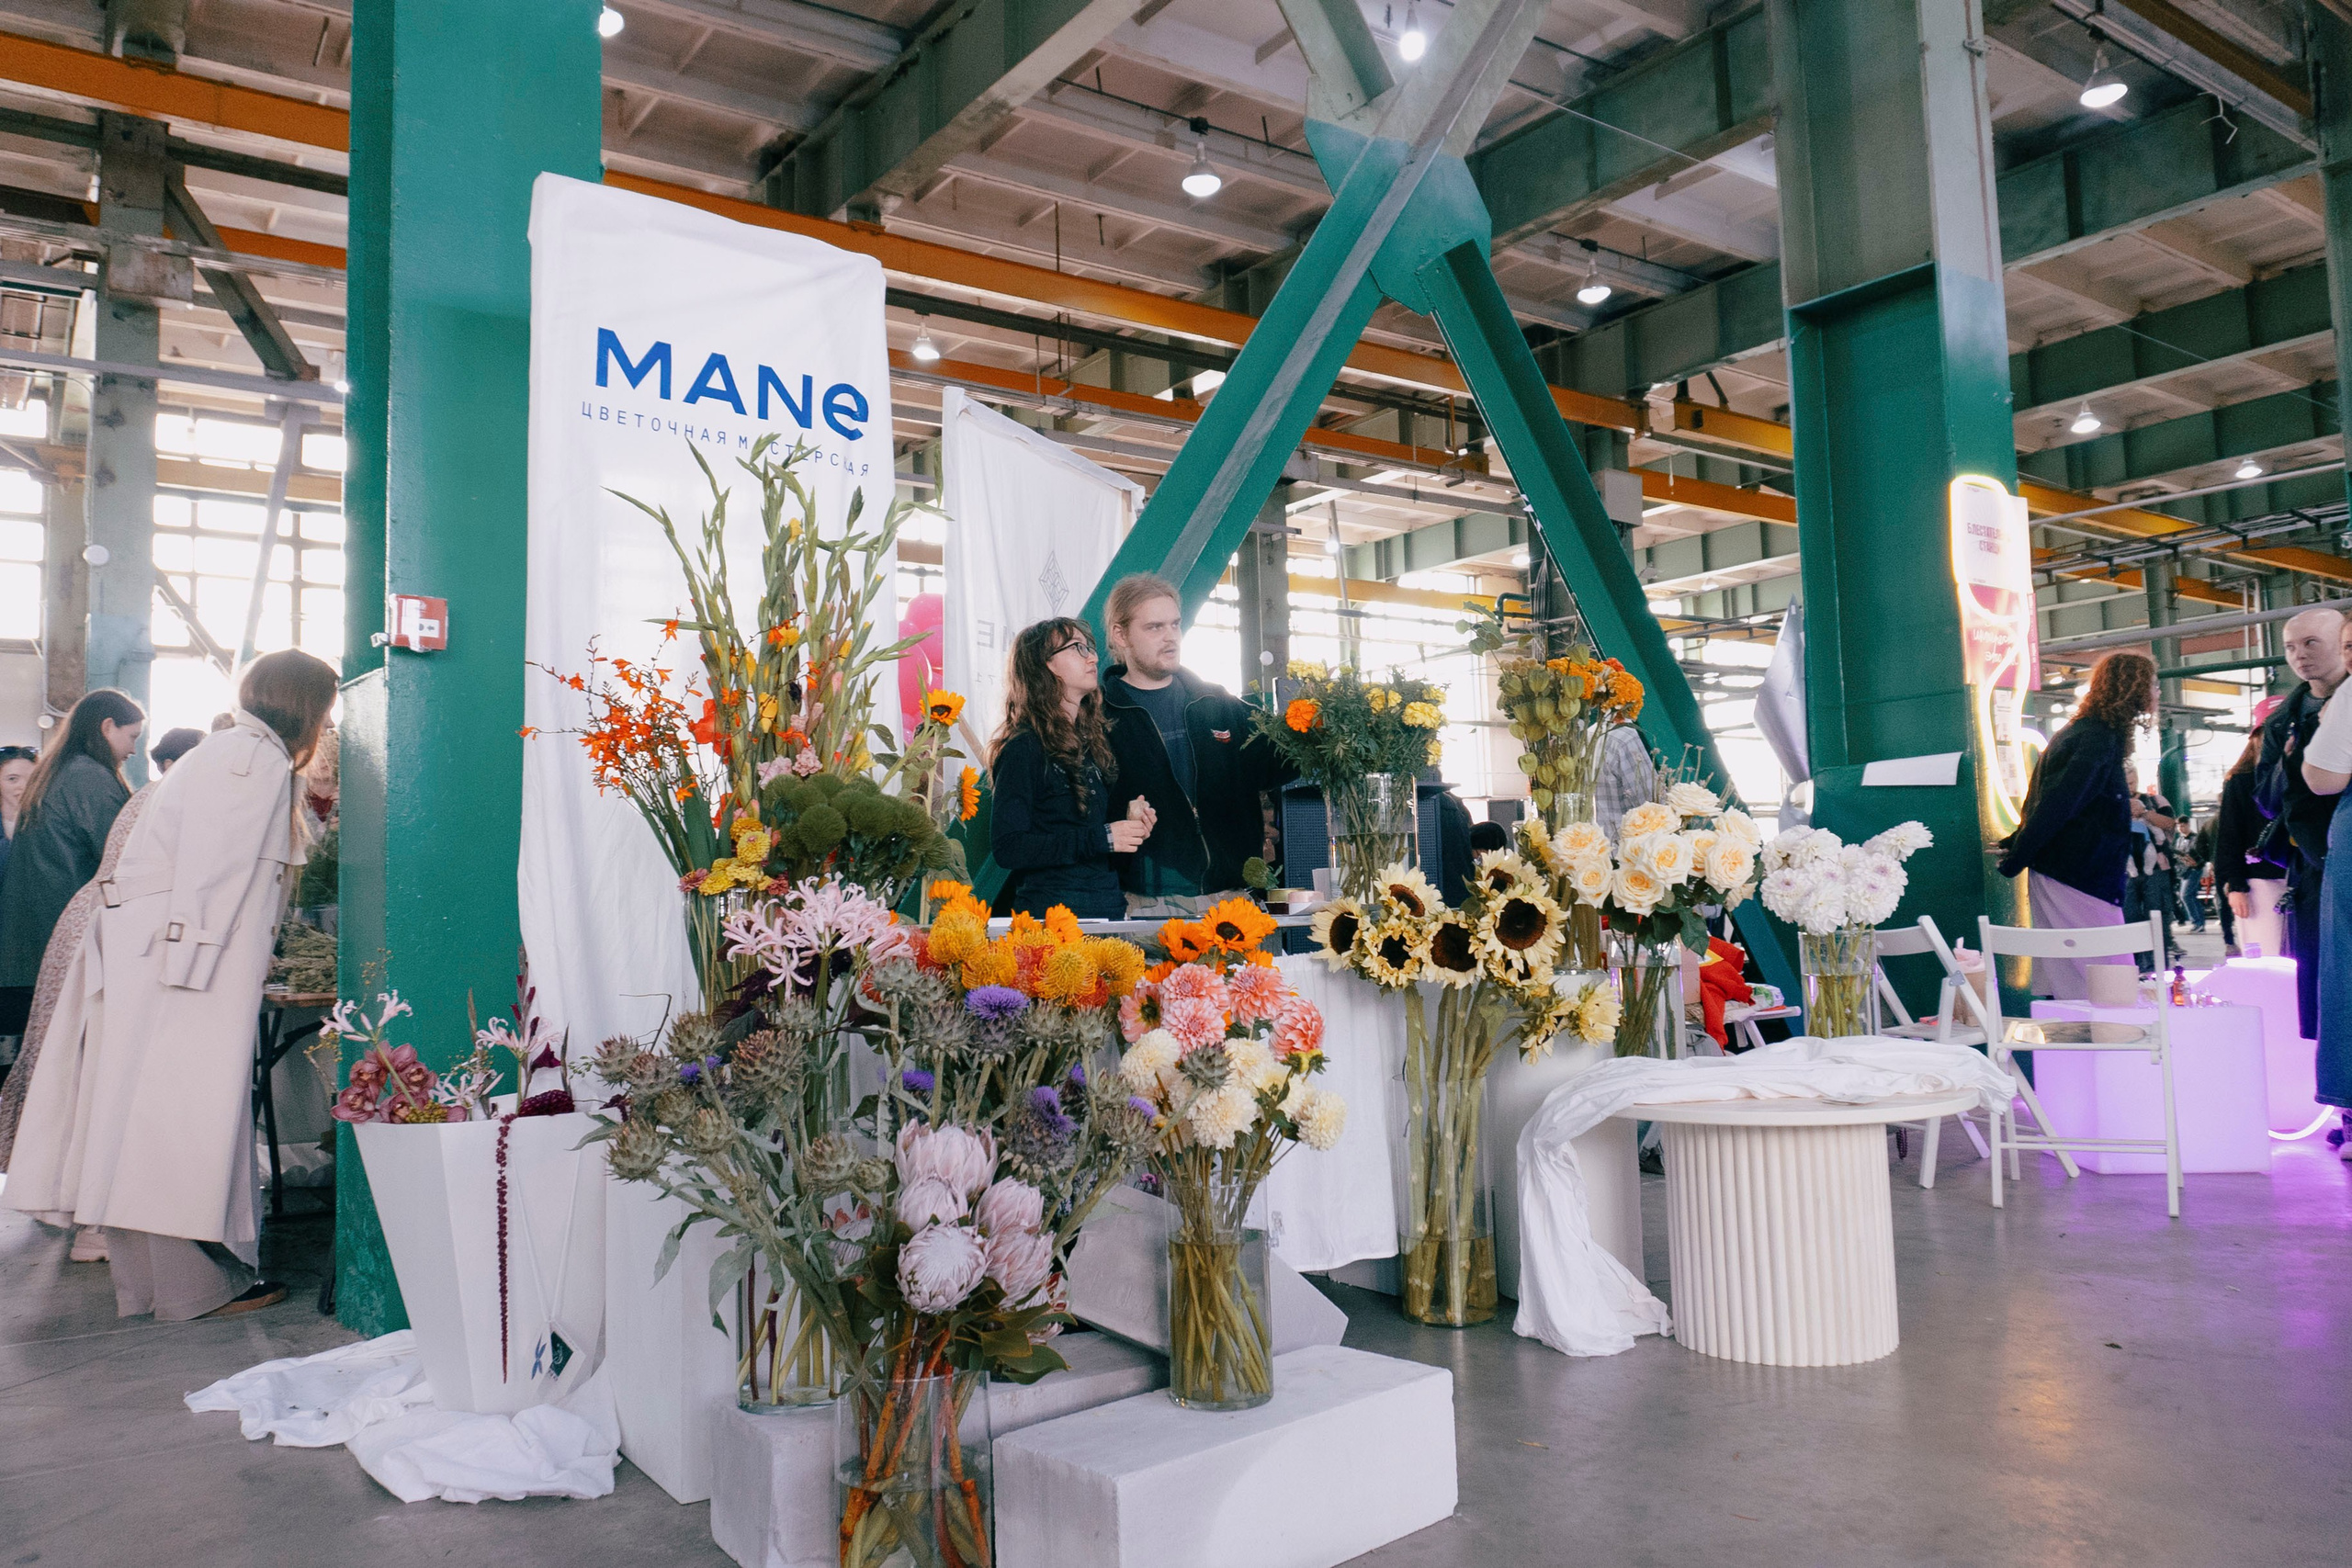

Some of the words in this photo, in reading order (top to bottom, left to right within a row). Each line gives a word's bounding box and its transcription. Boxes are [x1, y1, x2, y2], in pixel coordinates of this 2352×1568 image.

[595, 326, 869, 441] MANe
[582, 401, 727, 445] ЦВЕТОЧНАЯ
[739, 435, 869, 476] МСТРСАЯ
